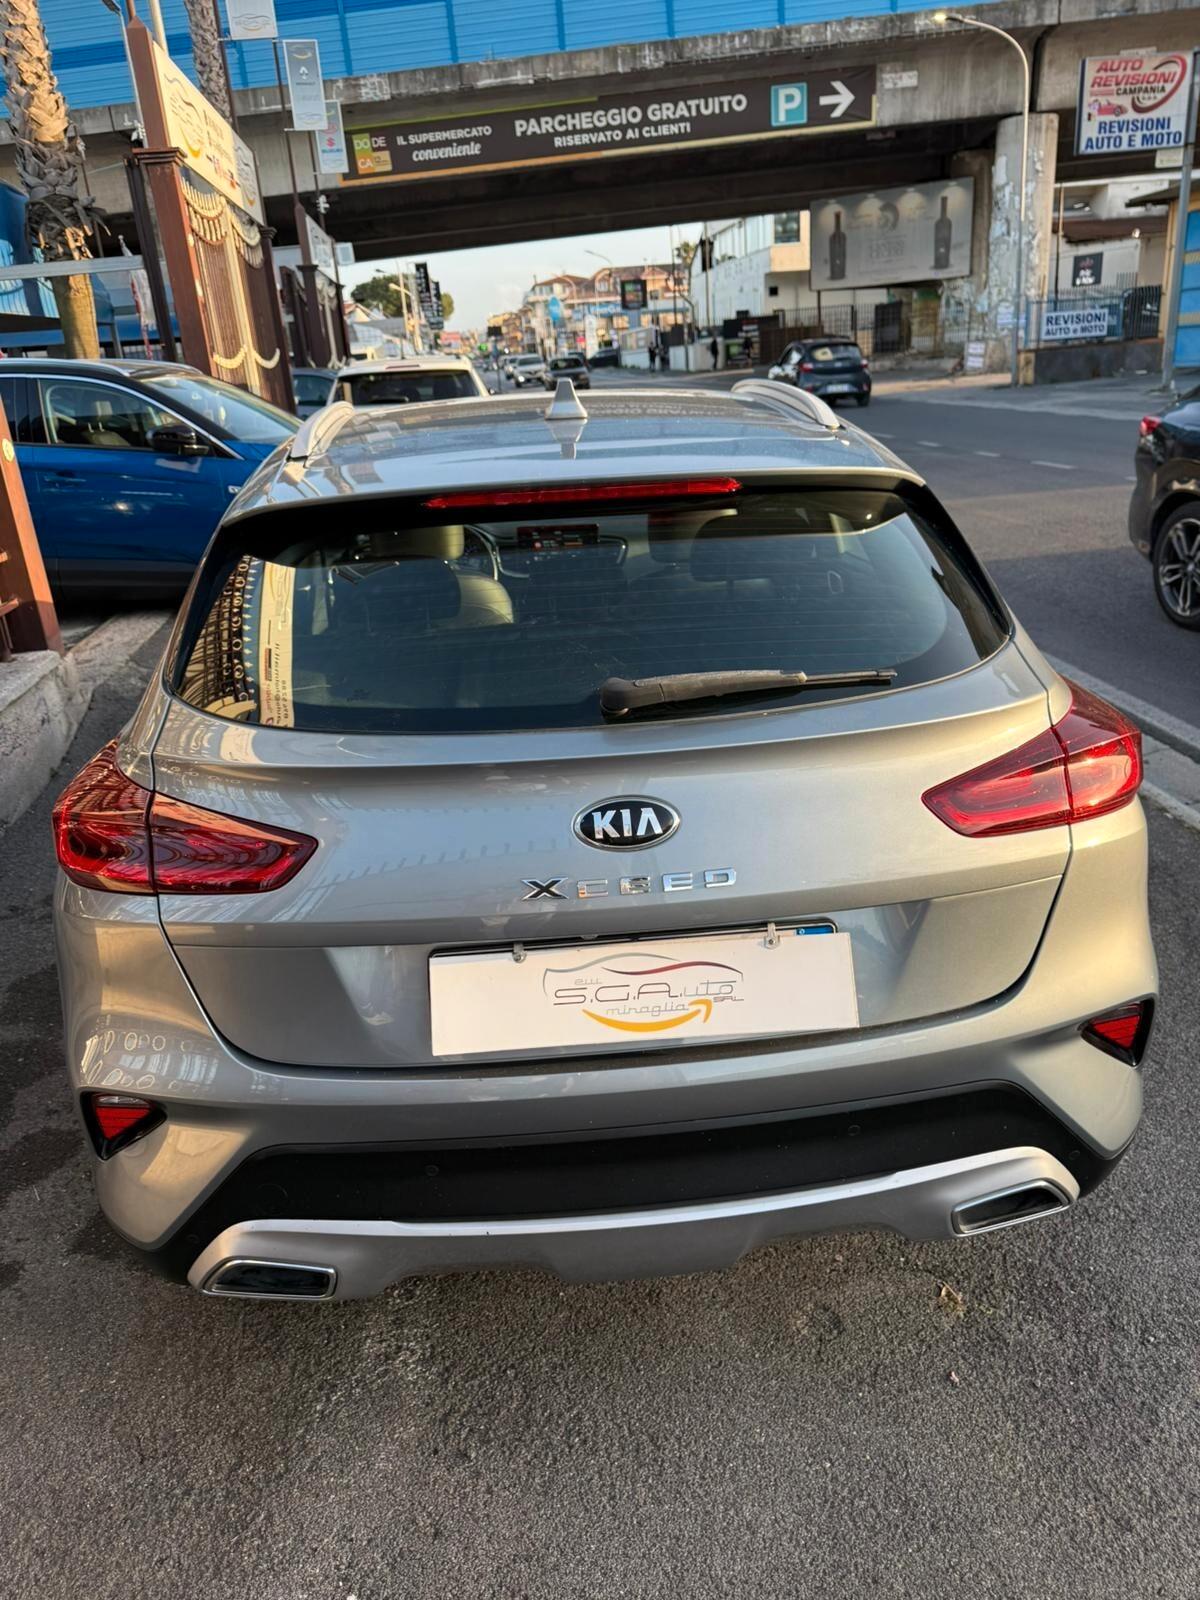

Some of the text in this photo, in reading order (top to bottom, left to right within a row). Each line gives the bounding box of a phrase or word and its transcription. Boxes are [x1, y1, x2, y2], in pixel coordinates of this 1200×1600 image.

[1096, 59, 1144, 73] AUTO
[1091, 71, 1177, 88] REVISIONI
[1116, 85, 1166, 96] CAMPANIA
[778, 88, 801, 122] P
[514, 94, 748, 137] PARCHEGGIO GRATUITO
[1098, 117, 1171, 134] REVISIONI
[396, 125, 492, 146] IL SUPERMERCATO
[554, 122, 691, 148] RISERVATO AI CLIENTI
[1084, 131, 1182, 151] AUTO E MOTO
[412, 141, 481, 161] conveniente
[1046, 311, 1106, 326] REVISIONI
[1045, 326, 1070, 336] AUTO
[1081, 324, 1105, 334] MOTO
[591, 807, 664, 840] KIA
[521, 867, 738, 900] XCEED
